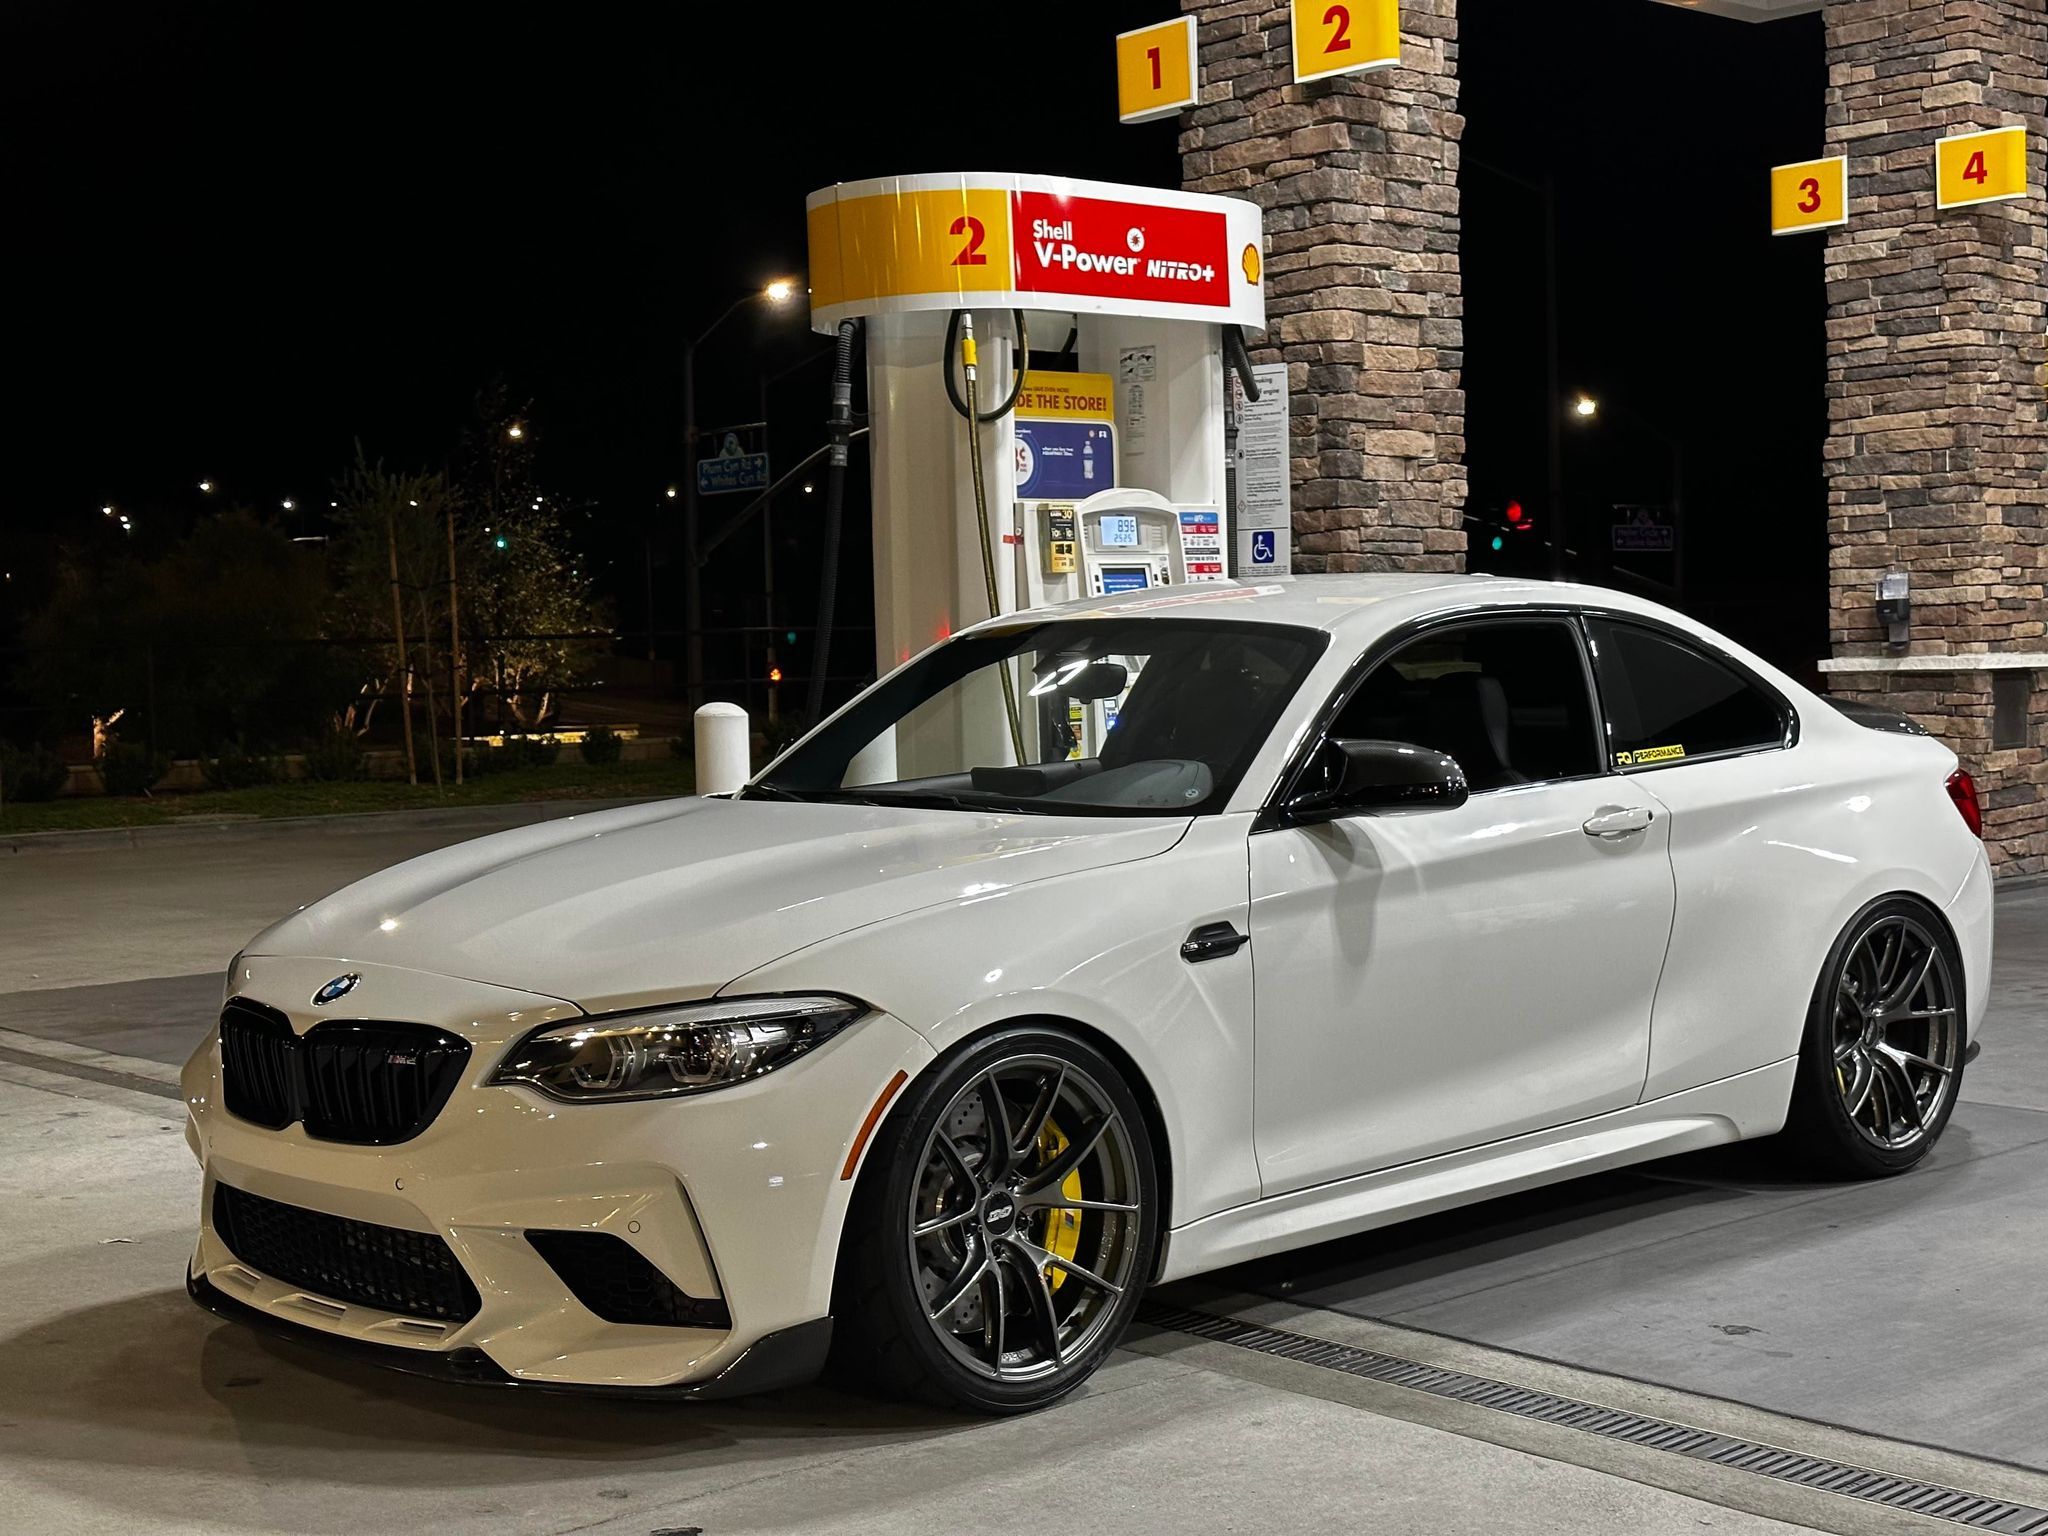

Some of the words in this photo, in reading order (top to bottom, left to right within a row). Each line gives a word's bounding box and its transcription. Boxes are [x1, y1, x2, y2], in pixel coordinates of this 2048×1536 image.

[1323, 5, 1351, 54] 2
[1147, 47, 1161, 90] 1
[1963, 151, 1987, 185] 4
[1797, 178, 1821, 213] 3
[949, 216, 987, 266] 2
[1032, 219, 1073, 241] Shell
[1033, 241, 1138, 275] V-Power
[1036, 394, 1060, 410] THE
[1063, 395, 1107, 411] STORE!
[1634, 746, 1684, 763] PERFORMANCE
